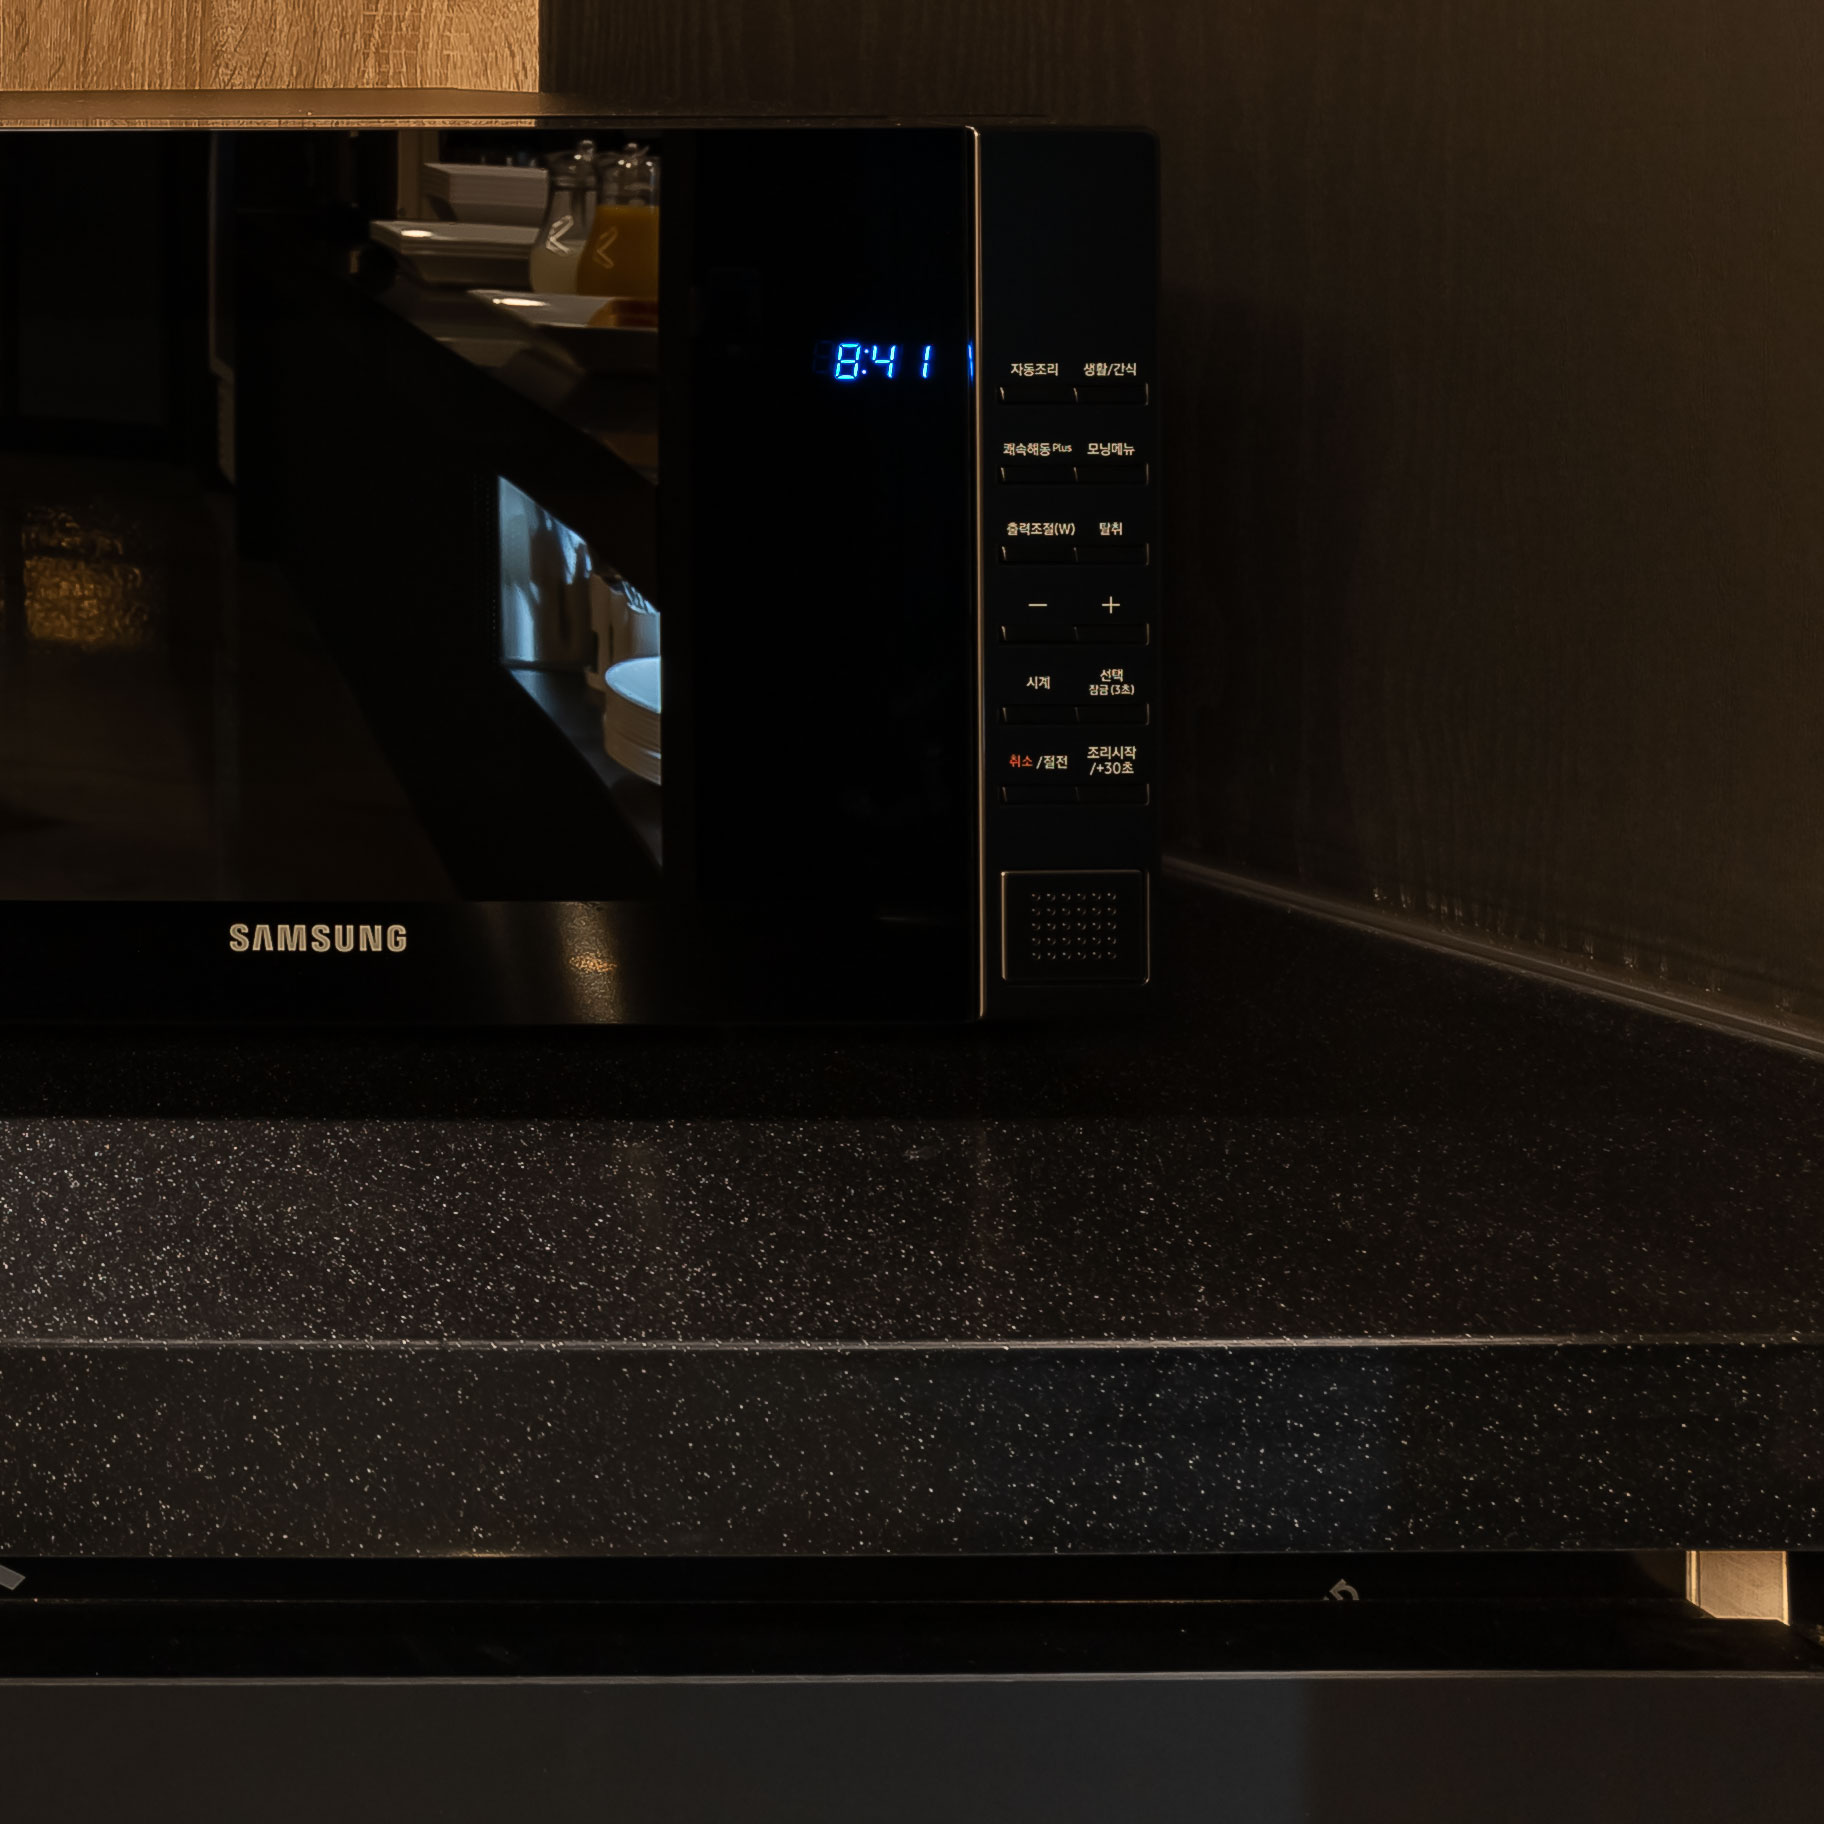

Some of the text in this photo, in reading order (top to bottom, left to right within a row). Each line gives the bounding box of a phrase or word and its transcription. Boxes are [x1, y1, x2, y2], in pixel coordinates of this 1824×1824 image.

[1010, 362, 1060, 377] 자동조리
[1083, 362, 1138, 377] 생활/간식
[1087, 442, 1136, 457] 모닝메뉴
[1006, 522, 1076, 537] 출력조절(W)
[1099, 522, 1123, 537] 탈취
[1026, 675, 1051, 690] 시계
[1100, 668, 1124, 683] 선택
[1087, 745, 1137, 760] 조리시작
[1009, 754, 1033, 768] 취소
[1089, 761, 1135, 776] /+30초
[228, 922, 407, 953] SAMSUNG
